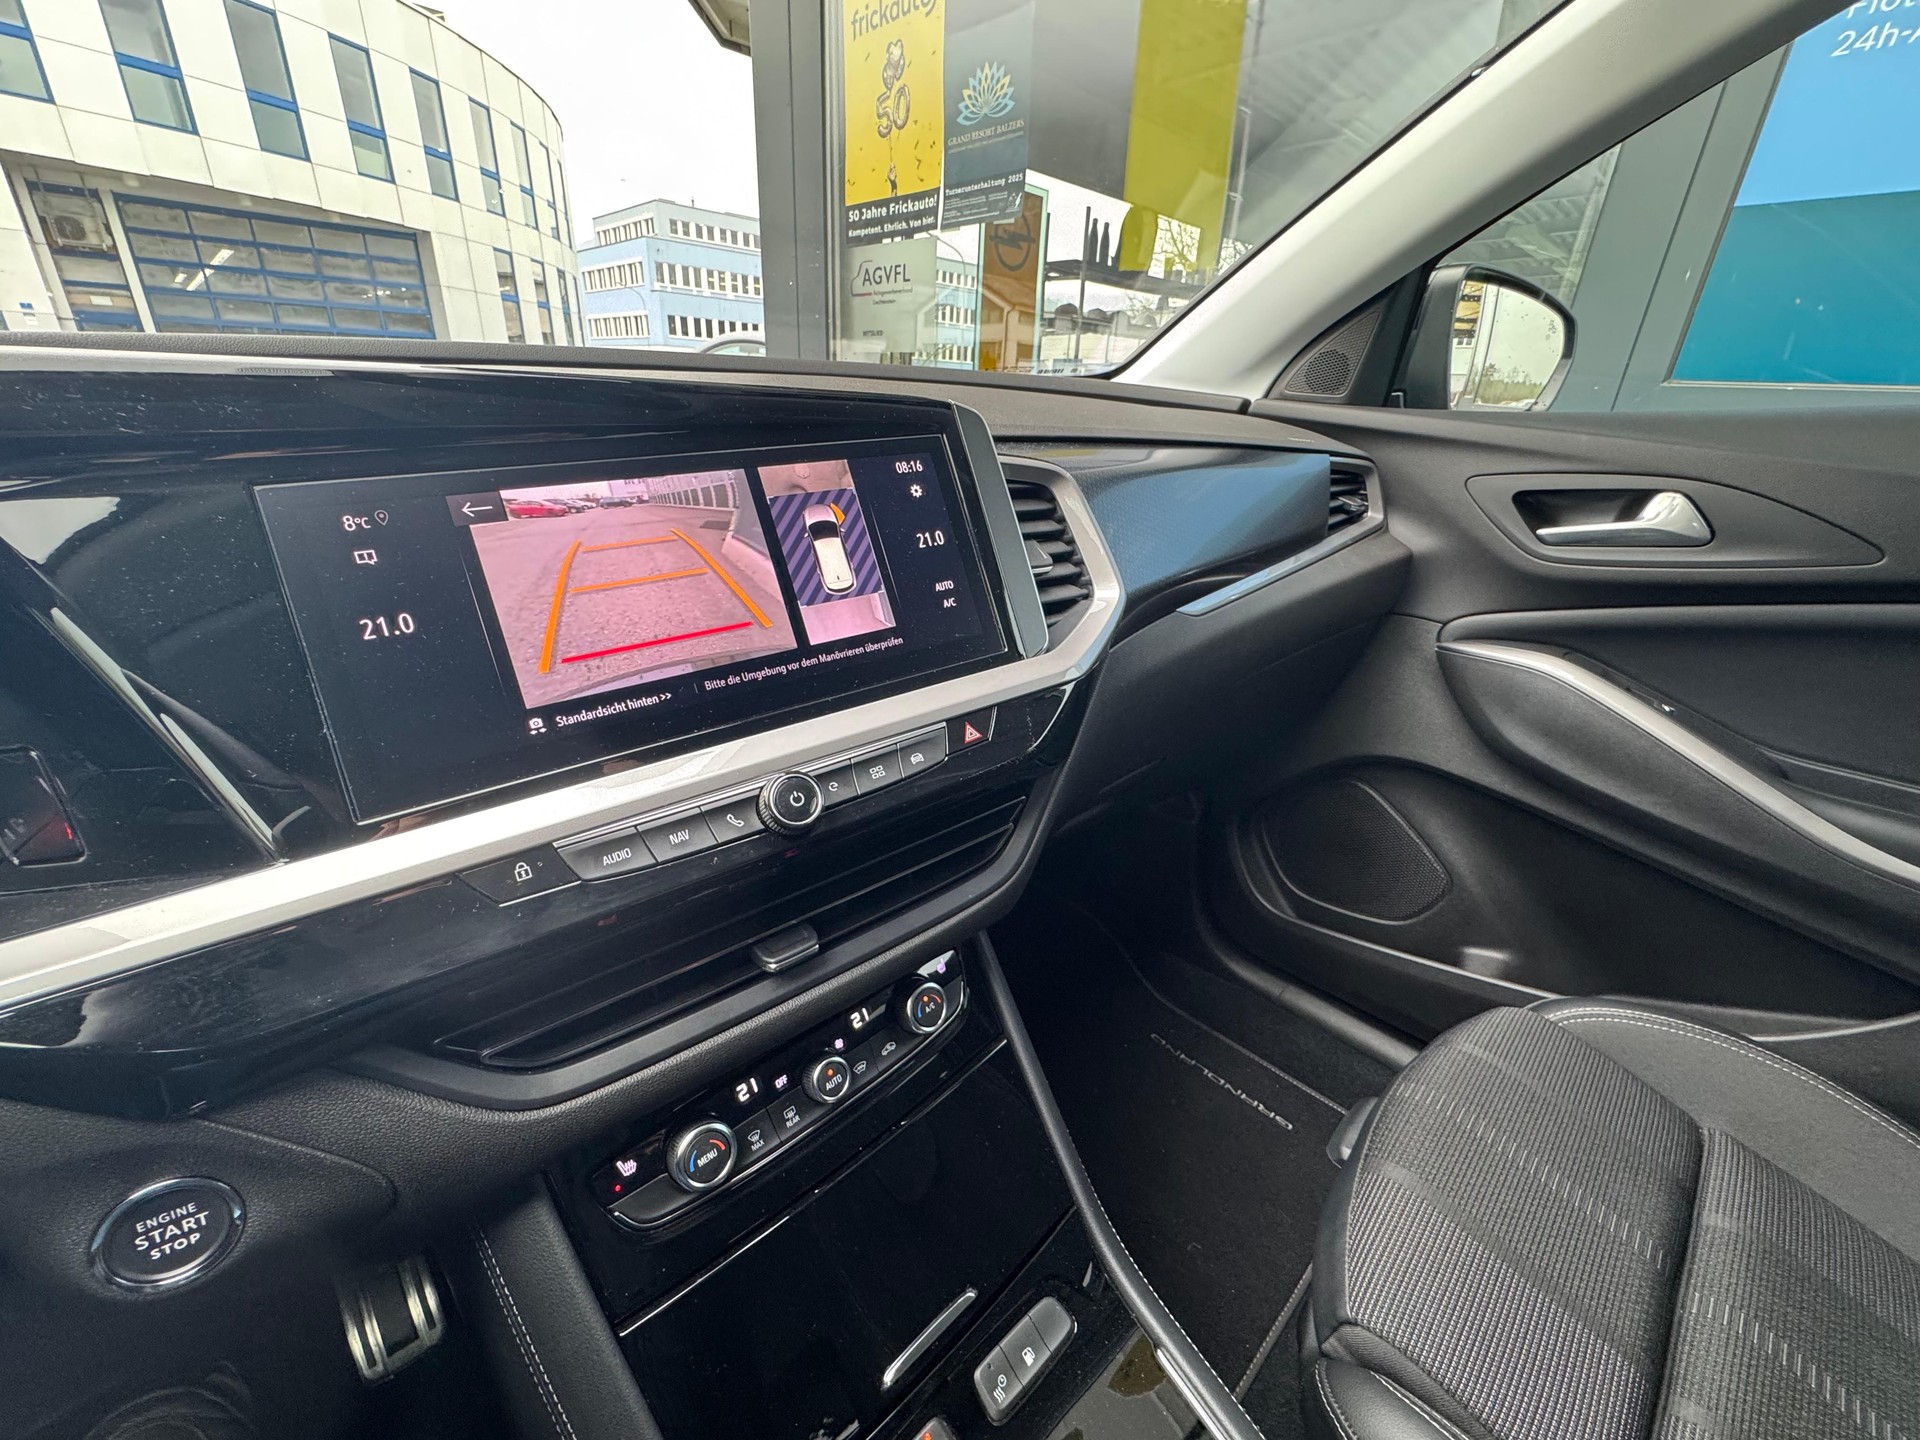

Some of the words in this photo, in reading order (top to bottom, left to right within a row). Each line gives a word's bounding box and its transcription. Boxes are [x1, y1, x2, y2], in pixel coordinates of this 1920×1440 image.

[947, 133, 971, 146] GRAND
[971, 127, 996, 140] RESORT
[1008, 172, 1023, 183] 2025
[848, 209, 860, 222] 50
[861, 206, 888, 220] Jahre
[889, 194, 937, 215] Frickauto!
[848, 225, 883, 237] Kompetent.
[883, 221, 909, 232] Ehrlich.
[909, 218, 922, 228] Von
[922, 216, 936, 226] hier.
[862, 263, 911, 286] AGVFL
[895, 460, 923, 474] 08:16
[916, 530, 945, 548] 21.0
[935, 580, 954, 592] AUTO
[943, 597, 957, 609] A/C
[359, 612, 415, 640] 21.0
[704, 679, 727, 691] Bitte
[727, 675, 742, 686] die
[741, 665, 787, 681] Umgebung
[787, 661, 800, 670] vor
[801, 657, 819, 668] dem
[818, 647, 865, 663] Manövrieren
[865, 637, 904, 652] überprüfen
[556, 702, 627, 727] Standardsicht
[626, 694, 660, 711] hinten
[669, 829, 690, 845] NAV
[602, 848, 632, 866] AUDIO
[924, 1002, 936, 1014] A/C
[850, 1007, 870, 1029] 21
[735, 1077, 759, 1102] 21
[774, 1074, 789, 1089] OFF
[825, 1073, 843, 1091] AUTO
[1150, 1033, 1293, 1130] GRANDLAND
[785, 1115, 800, 1128] REAR
[751, 1139, 765, 1151] MAX
[696, 1149, 718, 1167] MENU
[136, 1202, 197, 1233] ENGINE
[134, 1211, 209, 1251] START
[150, 1233, 201, 1260] STOP
